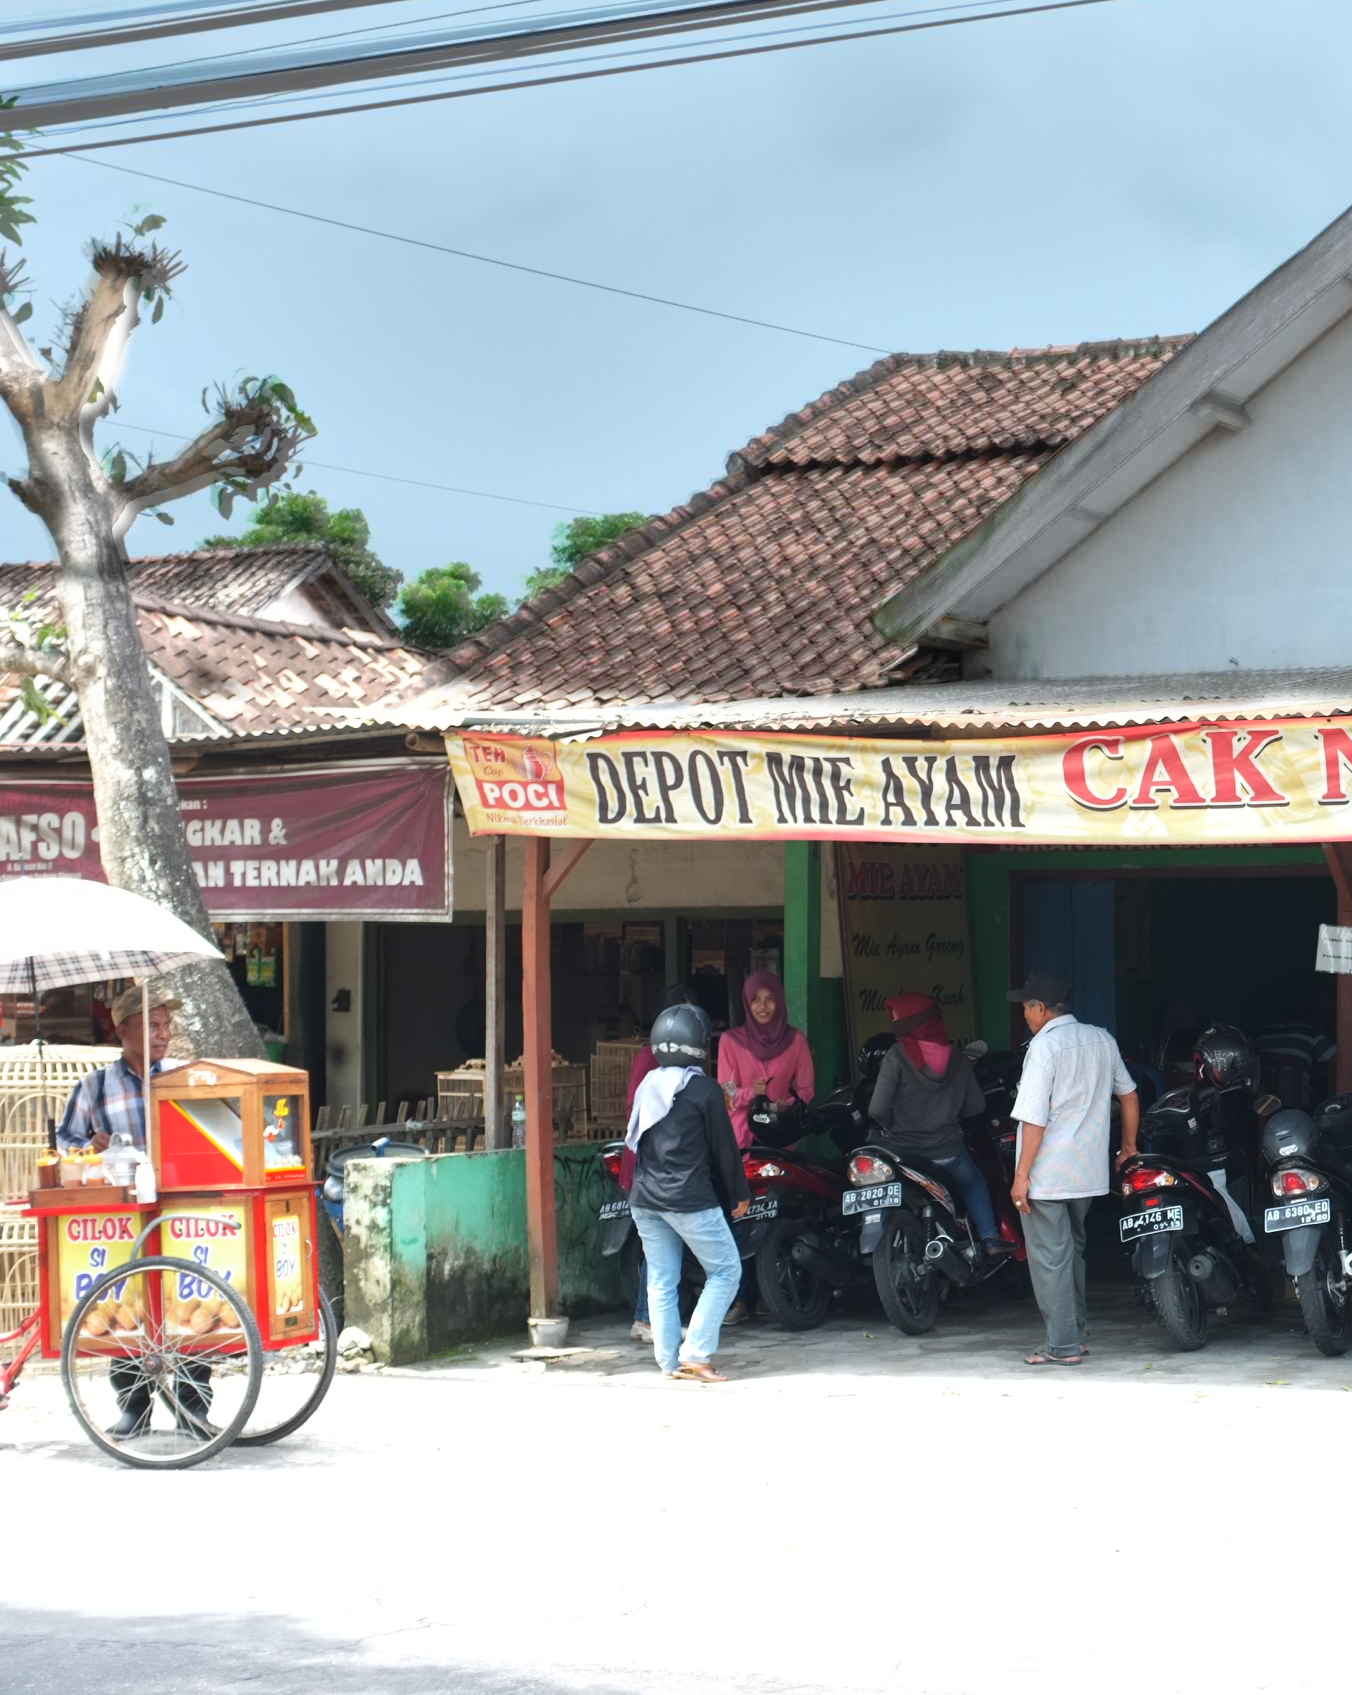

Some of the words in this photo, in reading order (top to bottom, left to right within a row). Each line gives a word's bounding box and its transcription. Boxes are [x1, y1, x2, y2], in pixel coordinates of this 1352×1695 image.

[469, 745, 506, 763] TEH
[1062, 726, 1290, 810] CAK
[482, 783, 560, 808] POCI
[586, 749, 753, 825] DEPOT
[765, 752, 865, 826] MIE
[879, 754, 1026, 828] AYAM
[178, 799, 200, 810] kan
[182, 818, 262, 847] GKAR
[268, 817, 288, 846] &
[230, 859, 338, 888] TERNAK
[343, 858, 424, 887] ANDA
[845, 1193, 856, 1202] AB
[861, 1188, 883, 1201] 2020
[1123, 1218, 1134, 1231] AB
[1267, 1210, 1280, 1221] AB
[67, 1216, 134, 1241] CILOK
[90, 1247, 106, 1267] SI
[193, 1245, 208, 1265] SI
